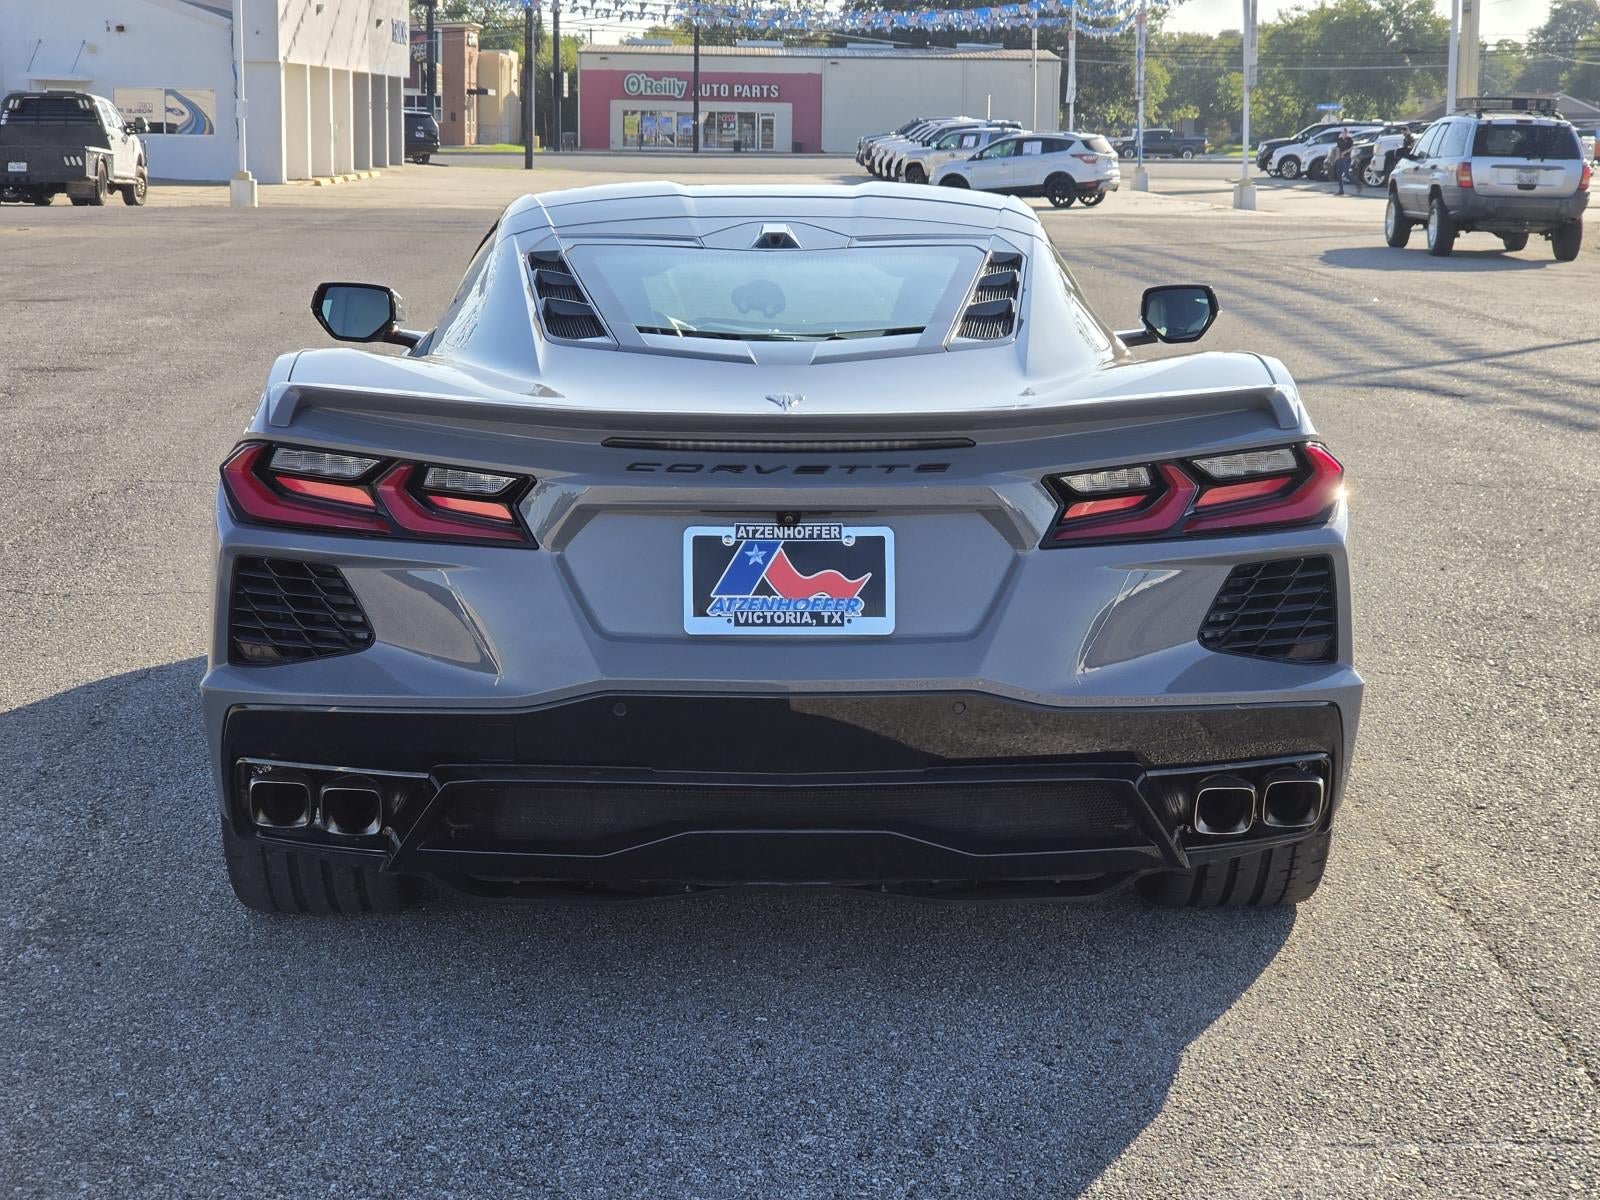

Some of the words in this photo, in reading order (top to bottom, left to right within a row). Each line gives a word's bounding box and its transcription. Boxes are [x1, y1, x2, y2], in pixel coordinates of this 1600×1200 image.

[624, 73, 687, 98] O'Reilly
[734, 85, 779, 97] PARTS
[625, 462, 951, 475] CORVETTE
[737, 526, 840, 539] ATZENHOFFER
[711, 597, 860, 615] ATZENHOFFER
[736, 611, 817, 626] VICTORIA,
[822, 611, 842, 624] TX
